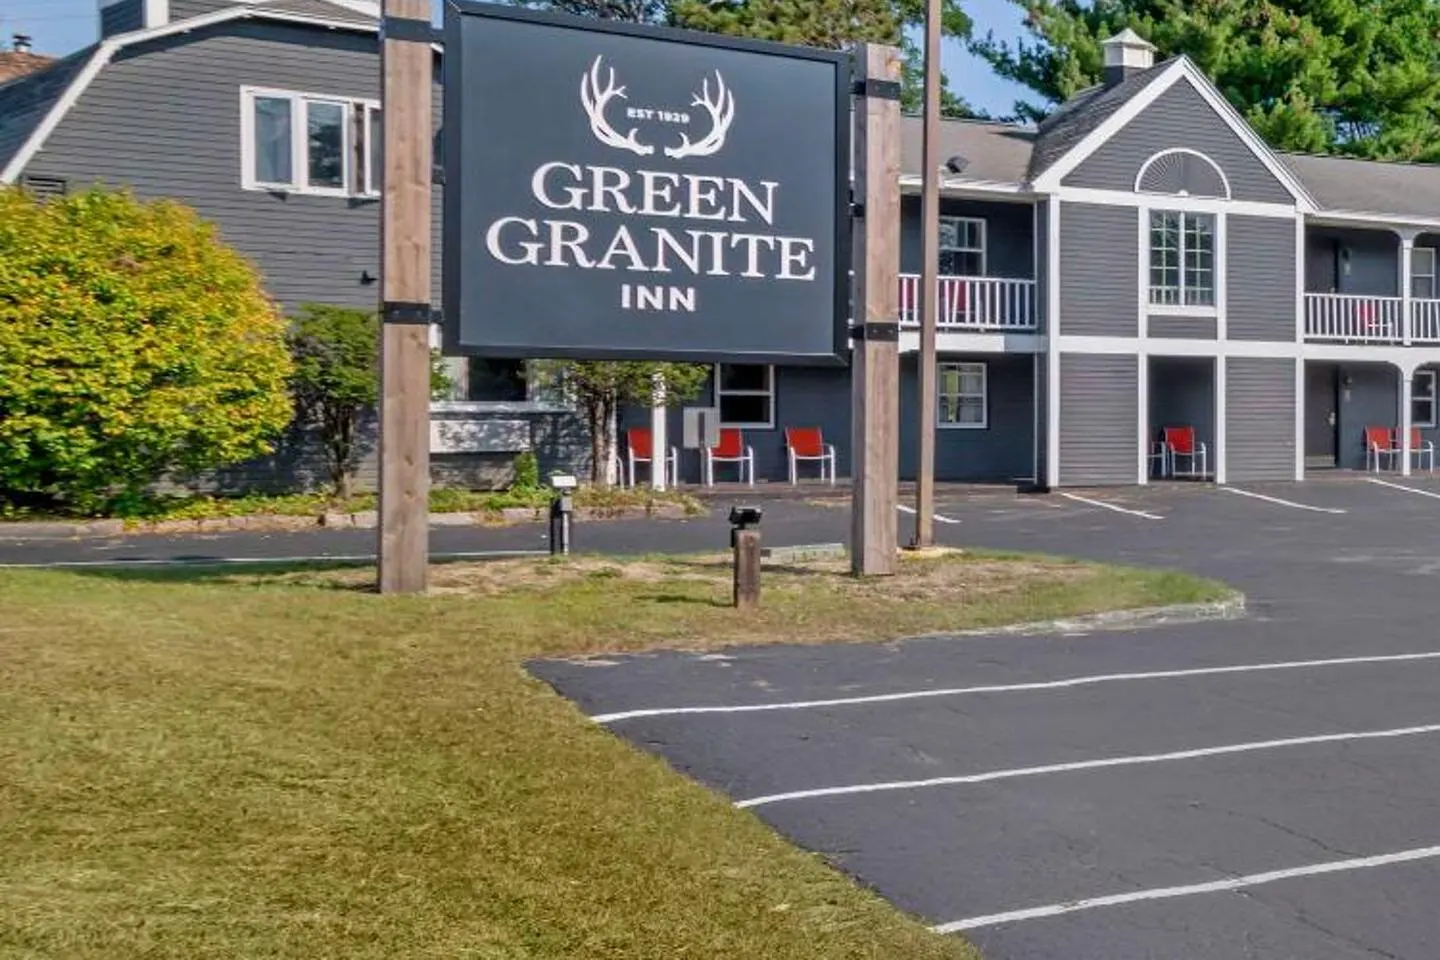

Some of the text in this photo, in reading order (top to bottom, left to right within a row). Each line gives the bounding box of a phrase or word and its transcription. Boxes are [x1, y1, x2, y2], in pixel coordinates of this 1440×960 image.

[627, 107, 654, 120] EST
[531, 161, 779, 226] GREEN
[486, 216, 816, 282] GRANITE
[621, 283, 696, 312] INN
